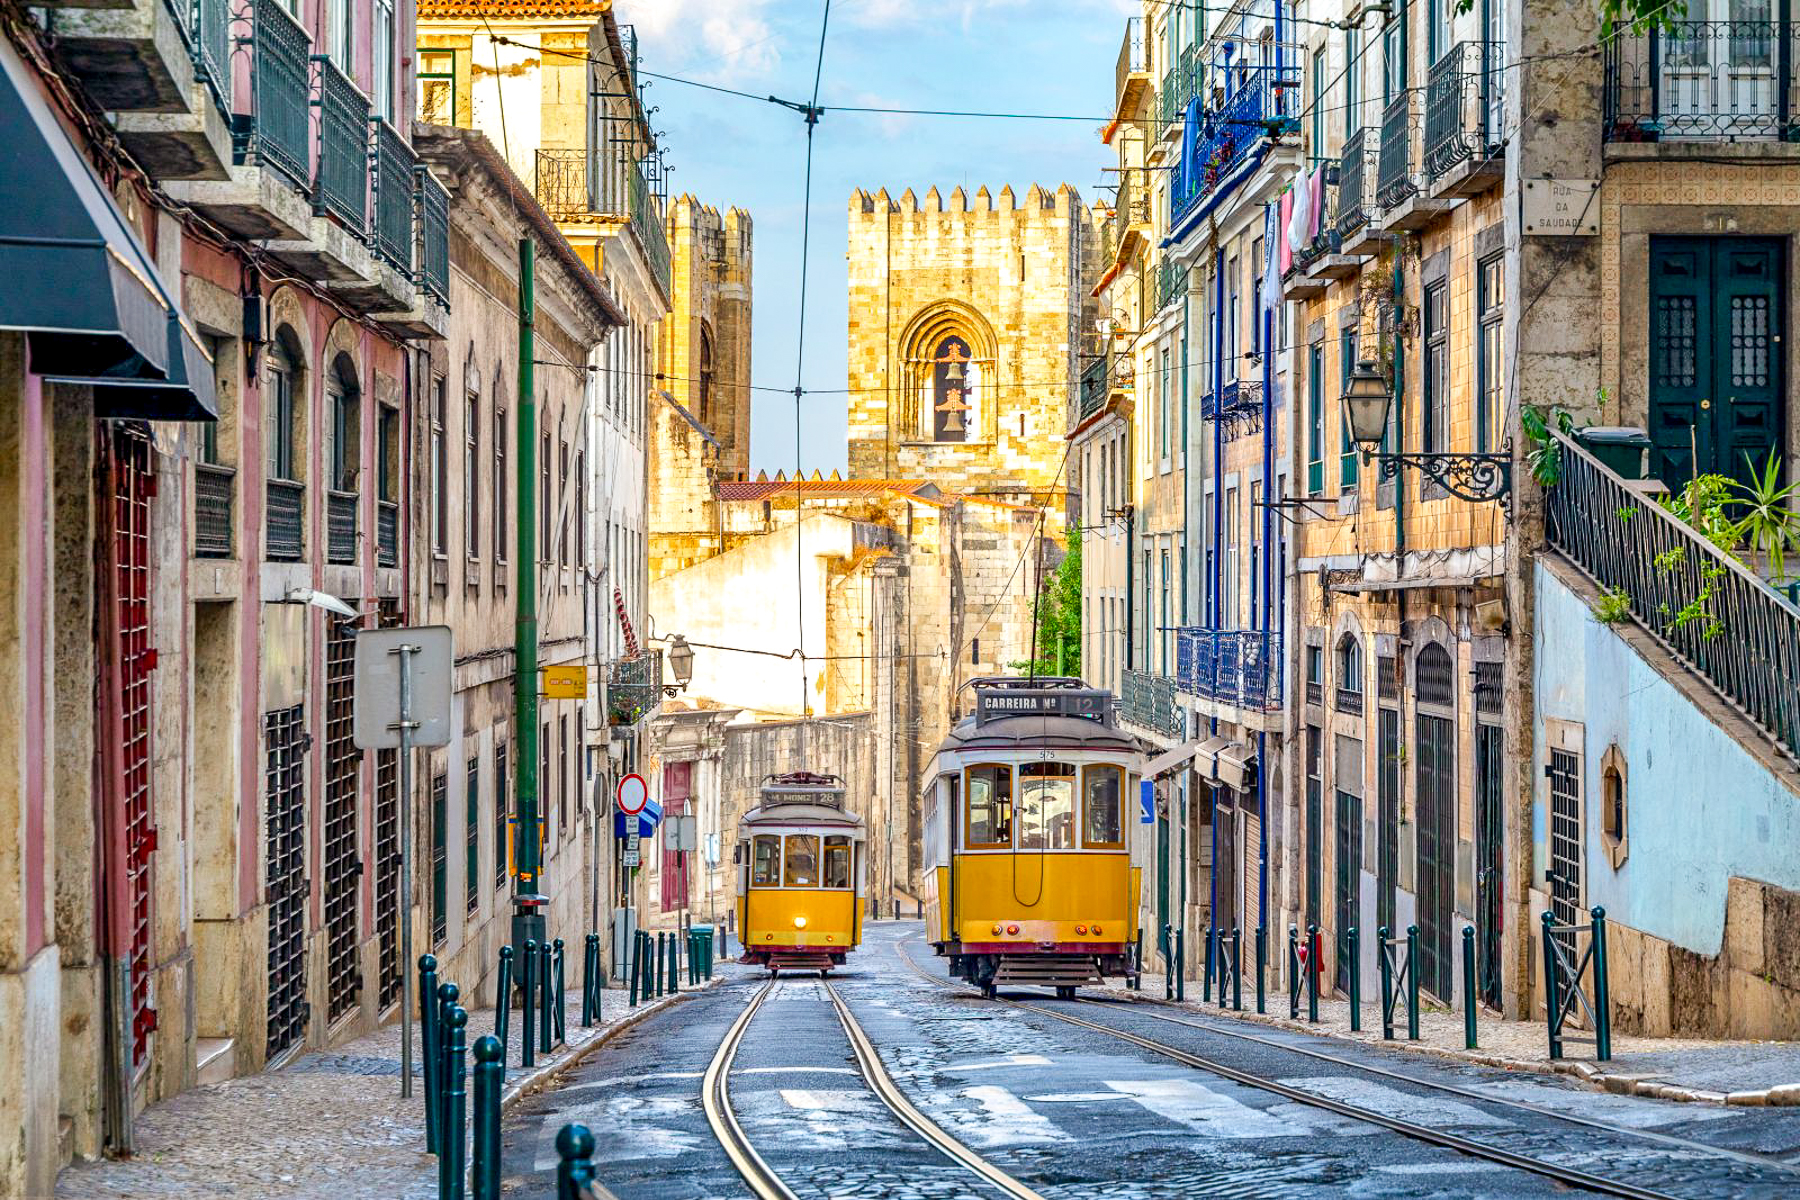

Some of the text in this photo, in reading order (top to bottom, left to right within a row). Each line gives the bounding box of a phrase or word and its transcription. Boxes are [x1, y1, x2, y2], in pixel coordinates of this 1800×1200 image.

[1553, 187, 1572, 196] RUA
[1556, 202, 1568, 212] DA
[984, 697, 1037, 709] CARREIRA
[1076, 698, 1093, 712] 12
[783, 794, 812, 802] MONIZ
[820, 793, 835, 803] 28
